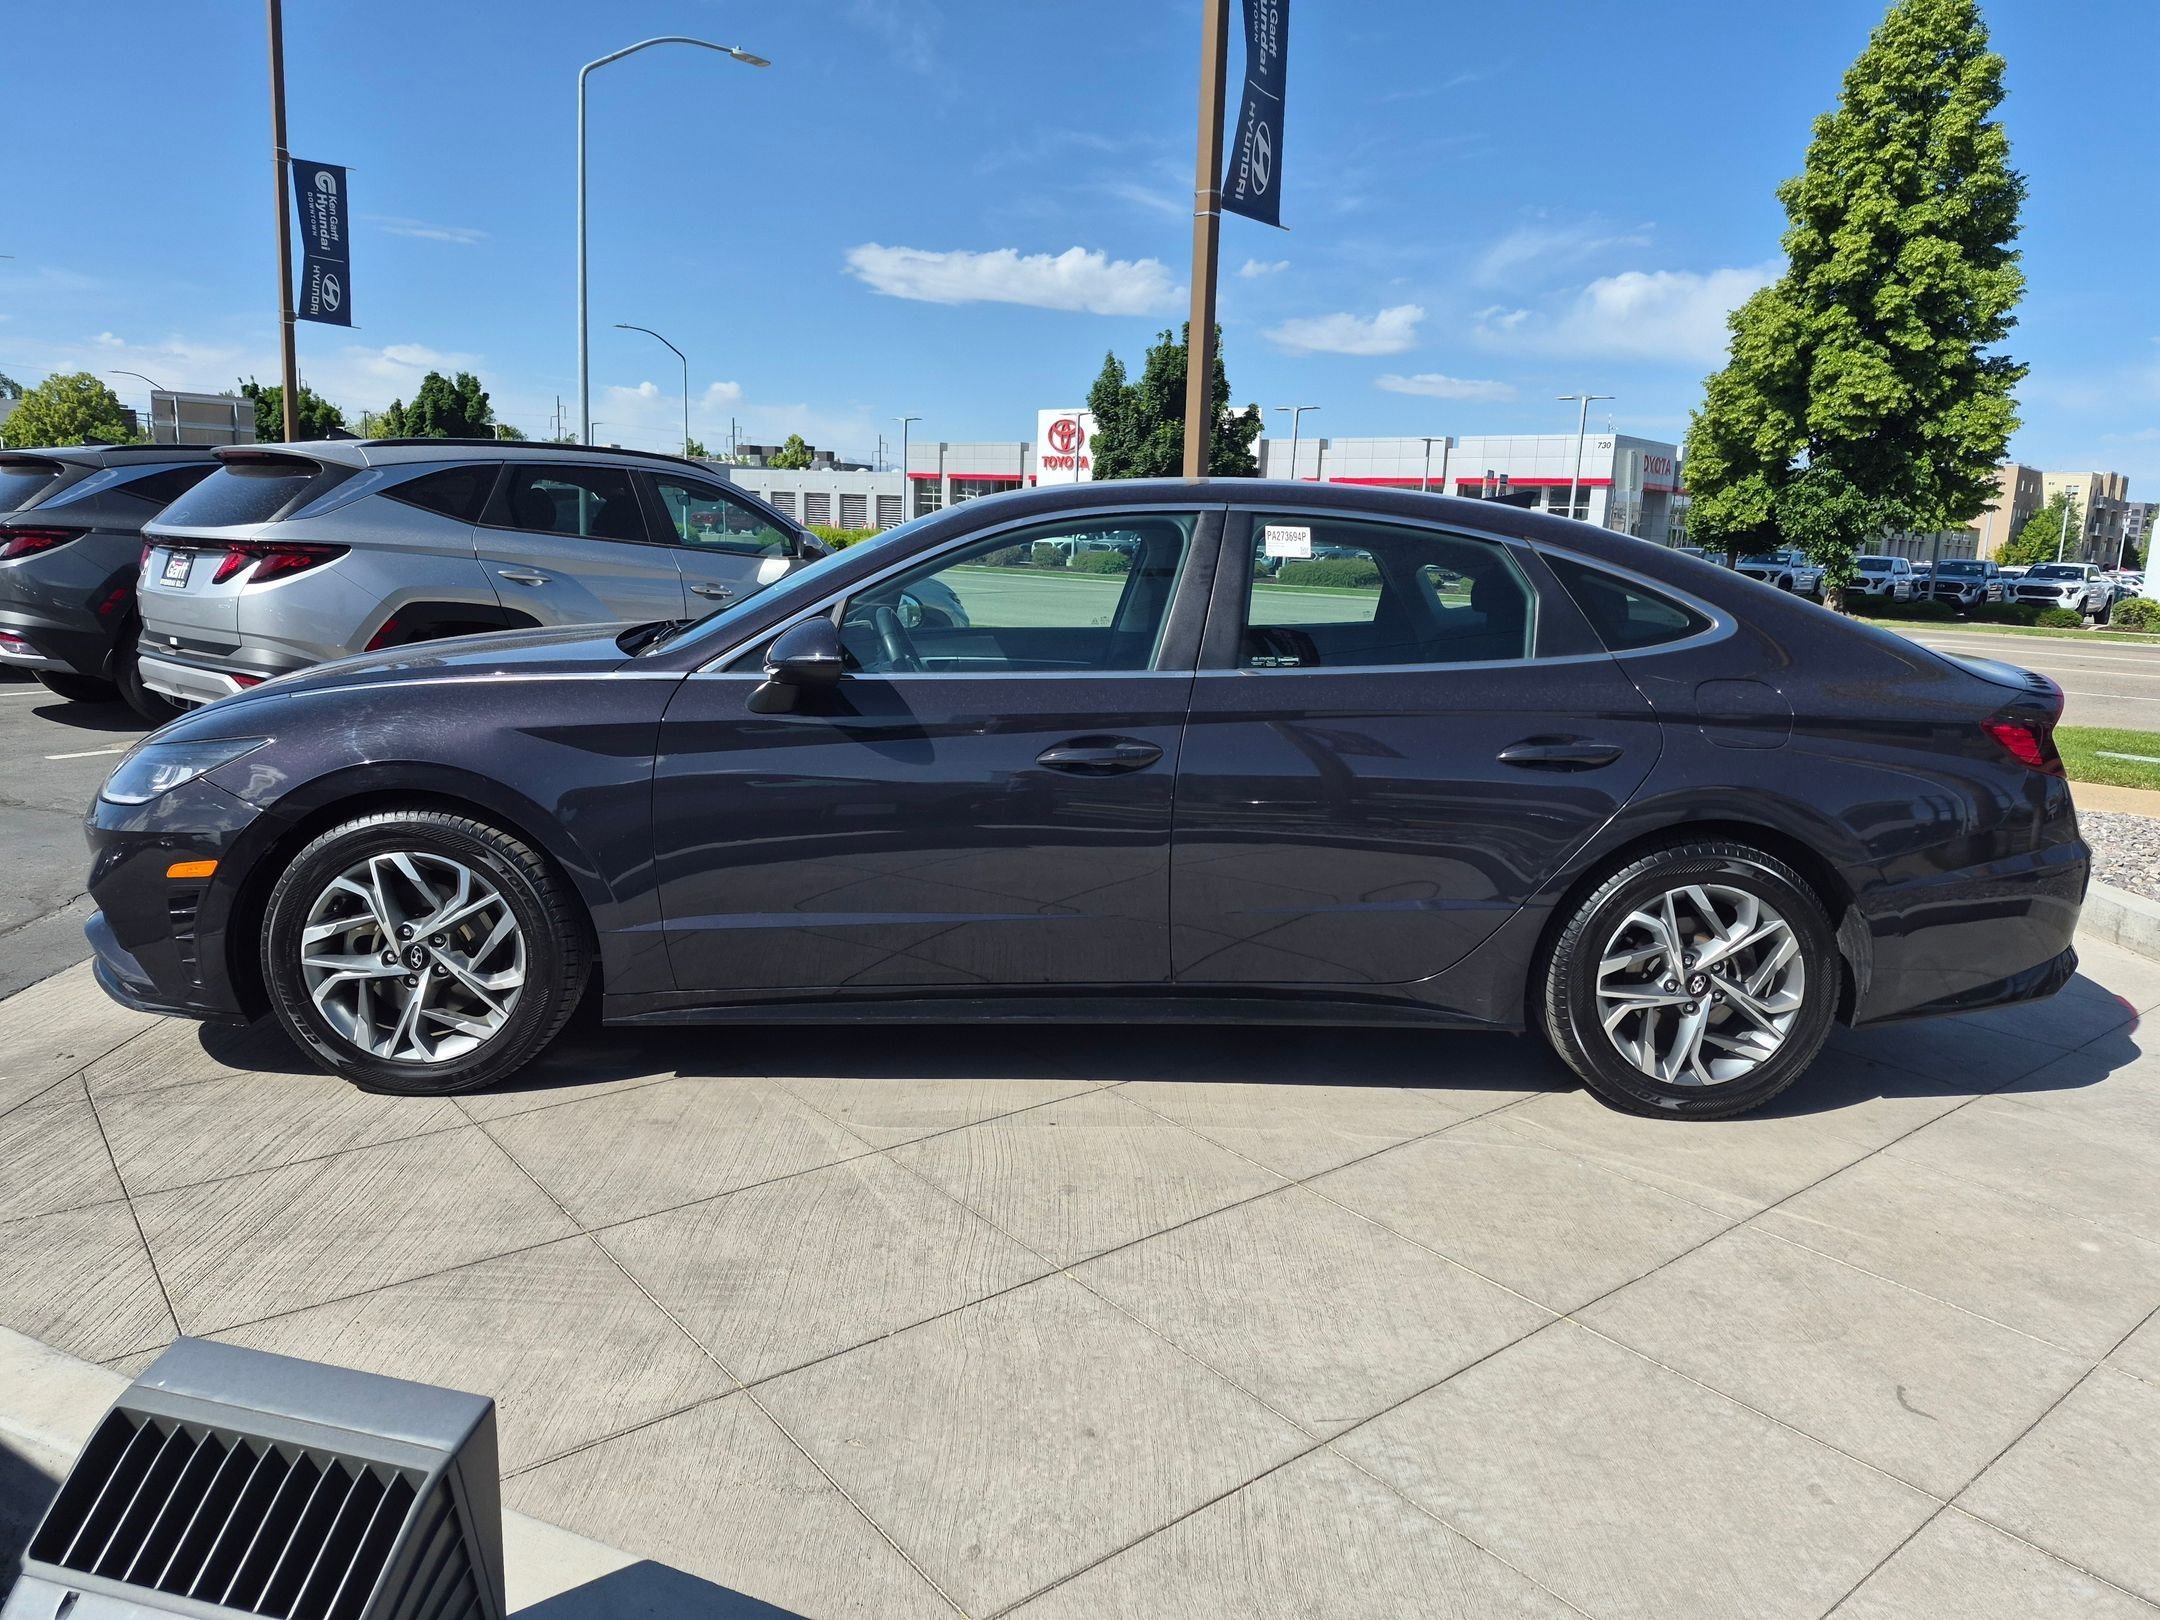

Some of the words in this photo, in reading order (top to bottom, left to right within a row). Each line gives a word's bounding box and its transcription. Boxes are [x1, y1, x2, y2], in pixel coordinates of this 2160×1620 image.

[1259, 0, 1269, 76] undai
[1268, 8, 1279, 58] Garff
[1234, 101, 1256, 200] HYUNDAI
[307, 191, 318, 237] DOWNTOWN
[315, 193, 331, 251] Hyundai
[328, 195, 337, 215] Ken
[329, 216, 339, 241] Garff
[310, 264, 320, 315] HYUNDAI
[1041, 455, 1090, 471] TOYOA
[1597, 441, 1612, 449] 730
